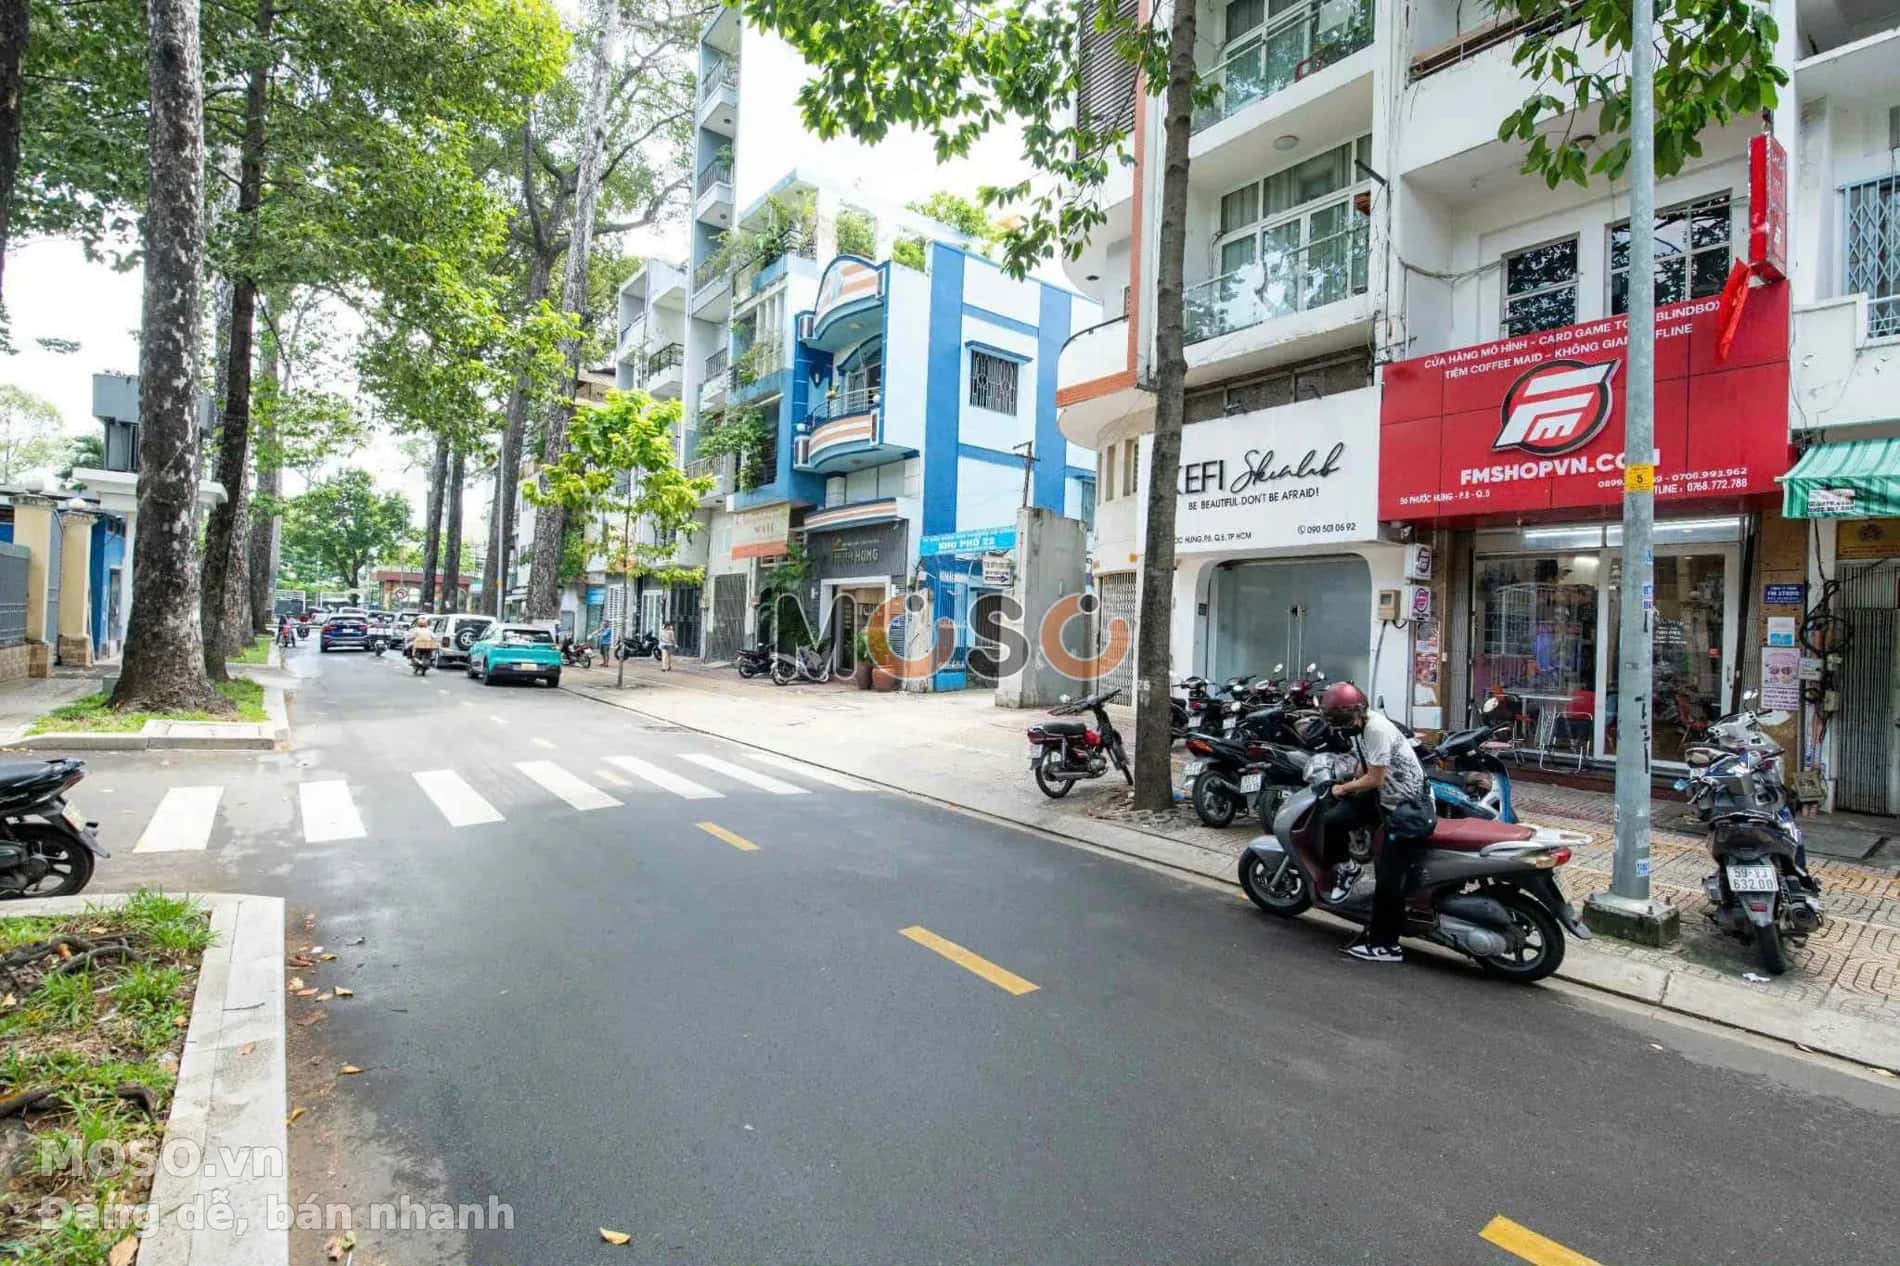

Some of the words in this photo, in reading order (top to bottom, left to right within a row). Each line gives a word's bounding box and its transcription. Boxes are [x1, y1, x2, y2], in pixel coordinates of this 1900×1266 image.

[1448, 352, 1479, 365] HÀNG
[1481, 344, 1498, 359] MÔ
[1500, 340, 1527, 353] HÌNH
[1539, 331, 1573, 345] CARD
[1575, 320, 1611, 338] GAME
[1470, 359, 1512, 373] COFFEE
[1513, 352, 1543, 366] MAID
[1555, 342, 1599, 358] KHÔNG
[1177, 460, 1223, 495] EFI
[1188, 501, 1198, 511] BE
[1268, 492, 1279, 502] BE
[1281, 487, 1319, 501] AFRAID!
